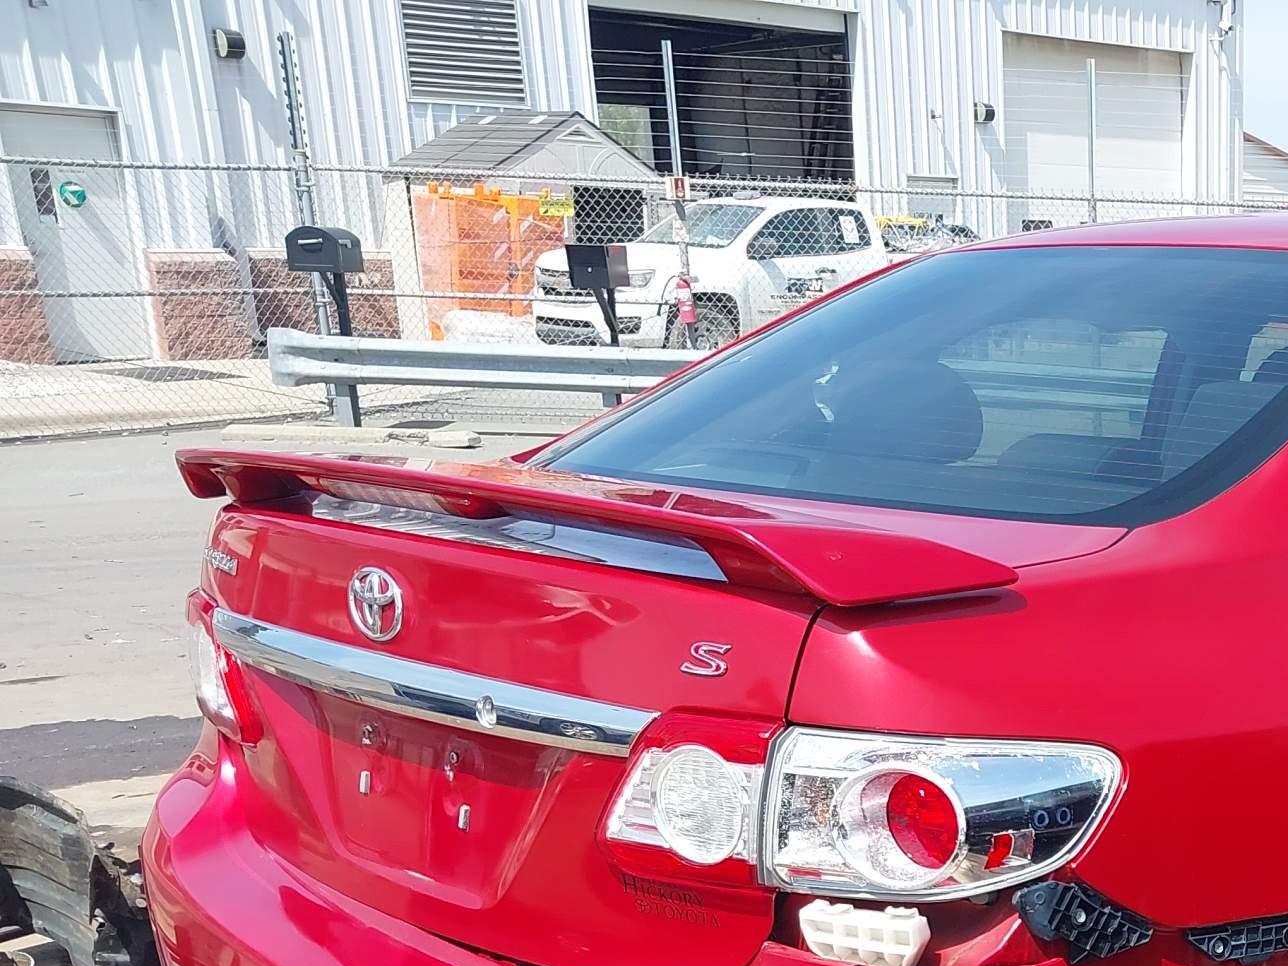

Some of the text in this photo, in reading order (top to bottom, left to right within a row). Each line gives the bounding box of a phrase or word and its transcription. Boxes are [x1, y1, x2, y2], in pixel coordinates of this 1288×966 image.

[681, 642, 732, 678] S
[622, 873, 704, 909] HICKORY
[655, 902, 720, 929] TOYOTA
